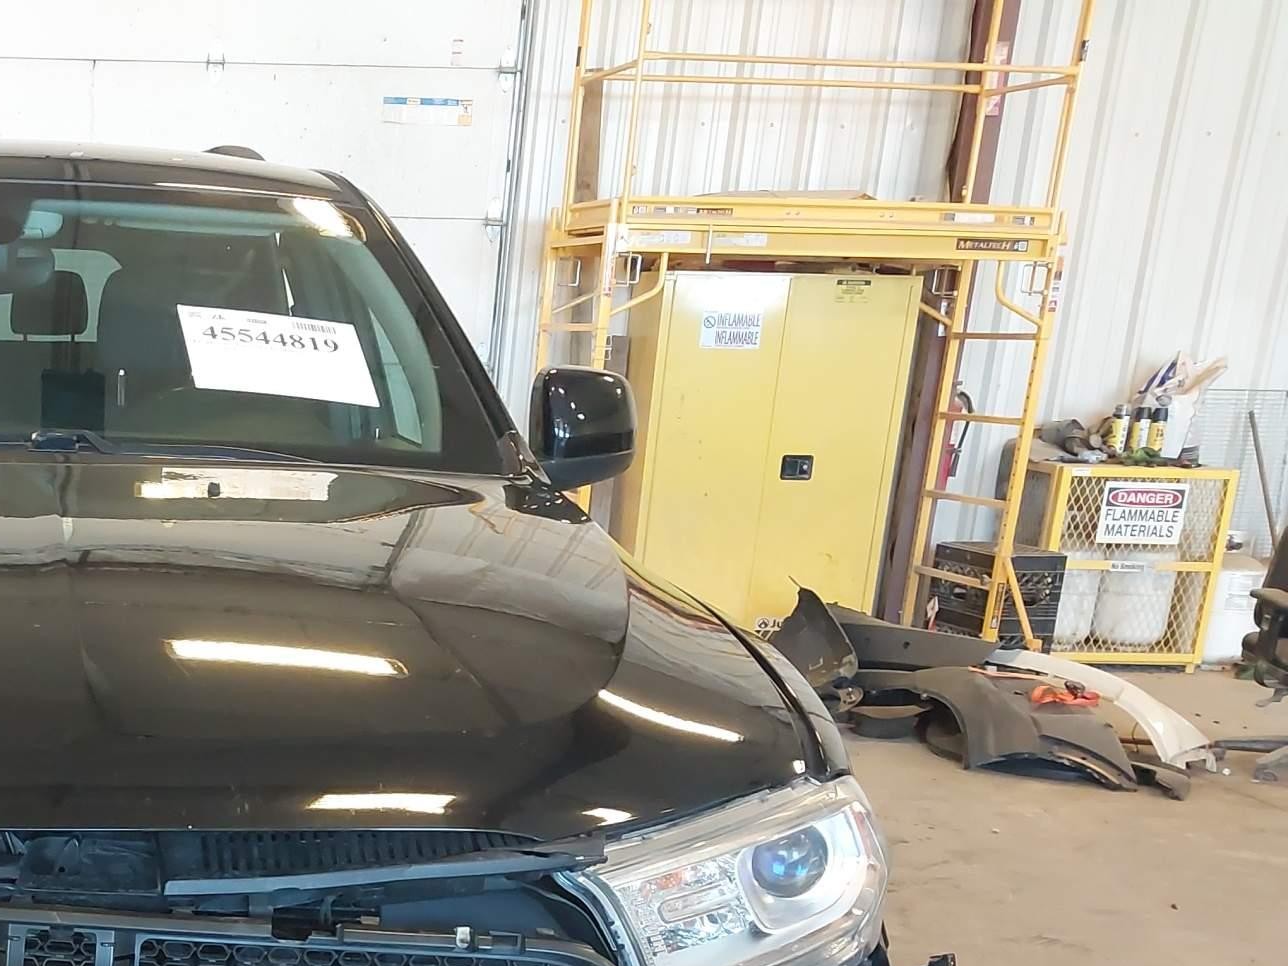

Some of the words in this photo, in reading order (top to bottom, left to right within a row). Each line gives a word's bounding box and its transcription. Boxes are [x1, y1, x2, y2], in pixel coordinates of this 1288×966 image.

[202, 325, 339, 352] 45544819
[1117, 492, 1173, 504] DANGER
[1105, 508, 1179, 523] FLAMMABLE
[1104, 524, 1173, 538] MATERIALS
